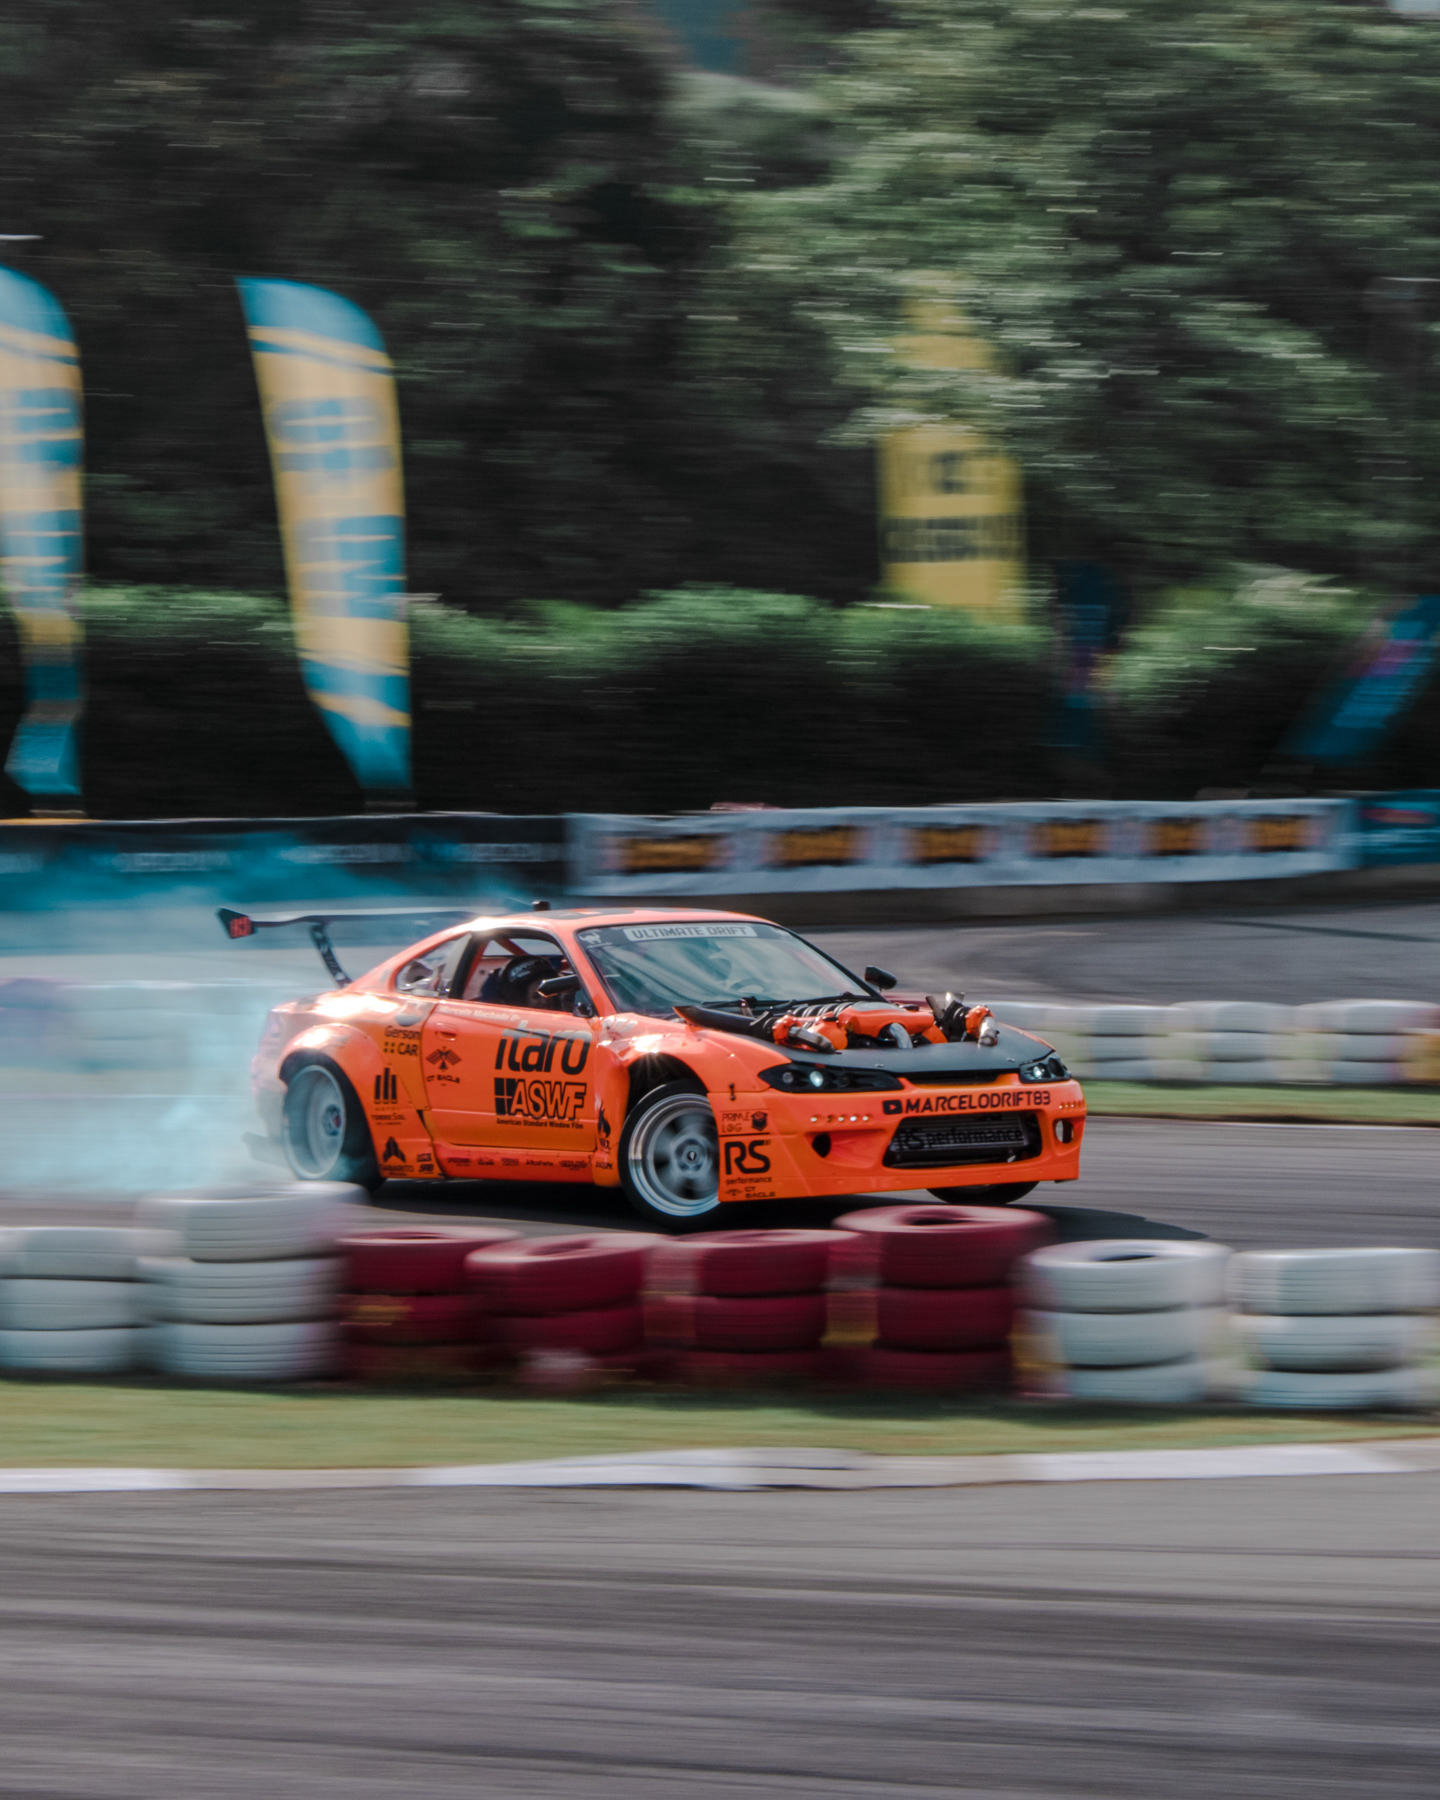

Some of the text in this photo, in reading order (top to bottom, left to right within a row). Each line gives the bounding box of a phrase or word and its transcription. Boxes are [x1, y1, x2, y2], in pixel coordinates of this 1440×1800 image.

[631, 925, 748, 939] ULTIMATE DRIFT
[384, 1025, 420, 1040] Gerson
[397, 1042, 418, 1056] CAR
[508, 1078, 588, 1121] ASWF
[905, 1091, 1050, 1114] MARCELODRIFT83
[721, 1111, 751, 1122] PRIME
[496, 1118, 522, 1126] American
[523, 1119, 548, 1127] Standard
[571, 1122, 584, 1130] Film
[724, 1139, 772, 1176] RS
[726, 1176, 773, 1187] performance
